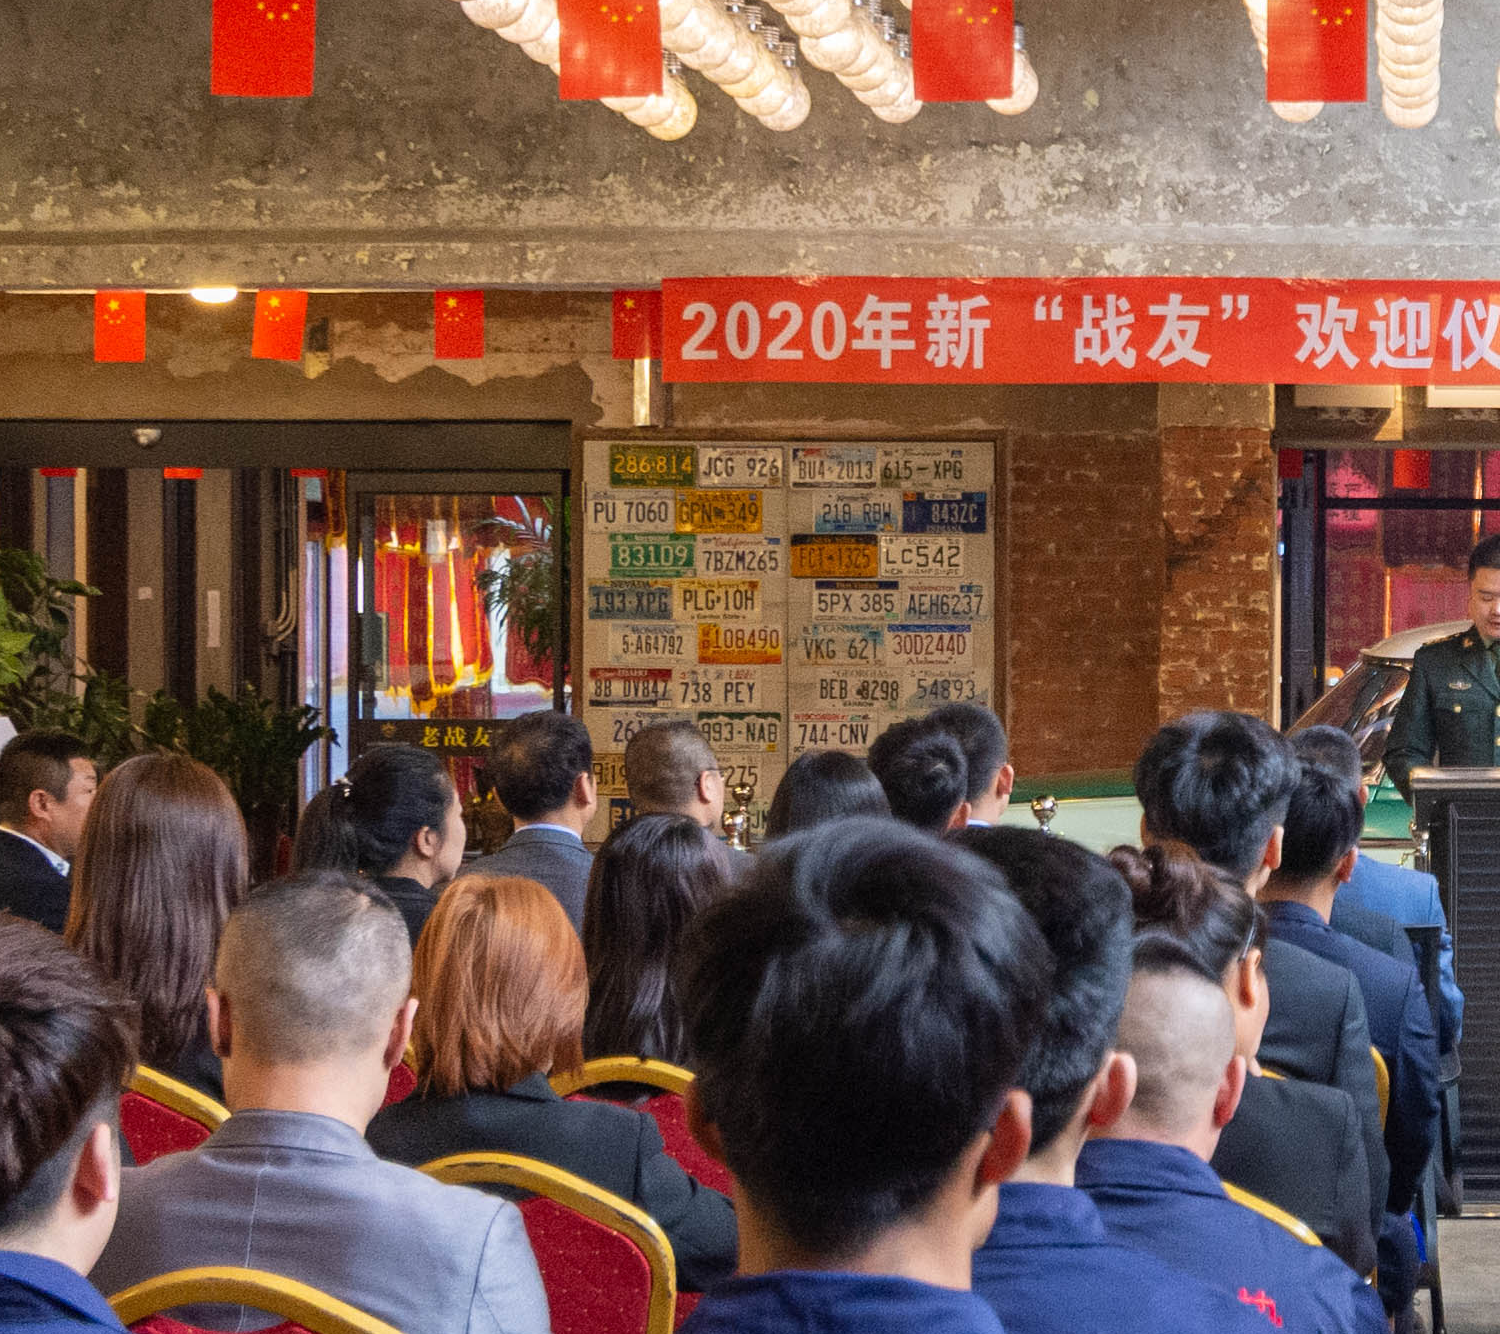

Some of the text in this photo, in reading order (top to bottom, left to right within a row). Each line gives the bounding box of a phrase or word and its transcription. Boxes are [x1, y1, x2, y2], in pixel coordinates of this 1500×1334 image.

[702, 456, 781, 478] JCG 926
[593, 500, 670, 524] PU 7060
[817, 592, 895, 613] 5PX 385
[680, 681, 756, 704] 738 PEY
